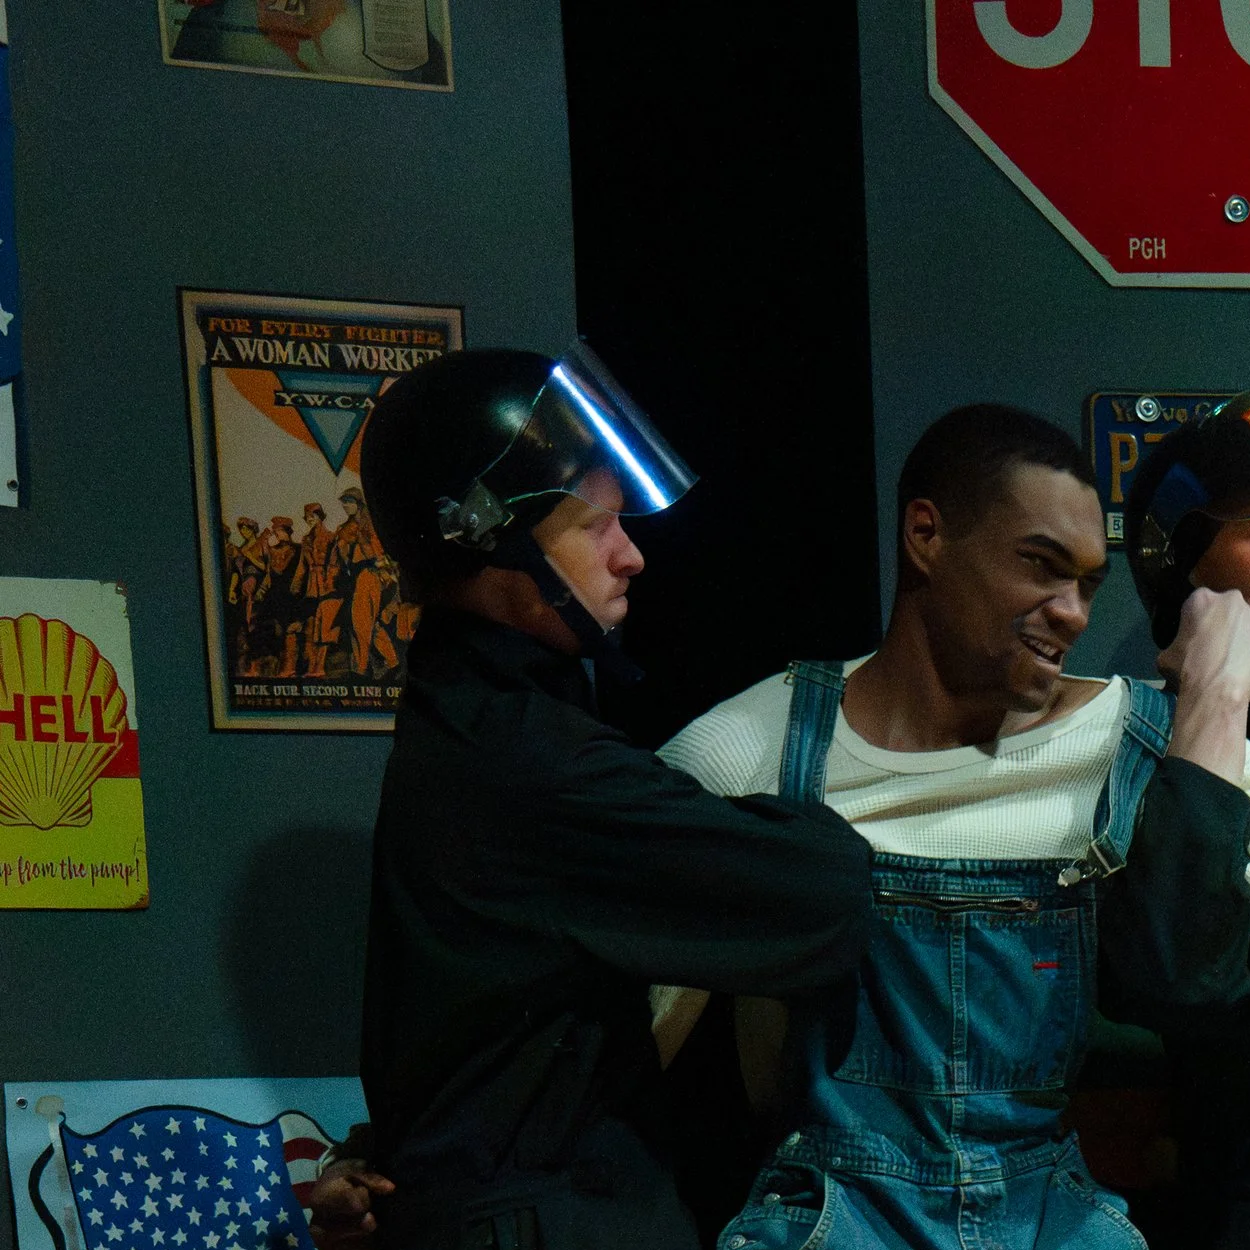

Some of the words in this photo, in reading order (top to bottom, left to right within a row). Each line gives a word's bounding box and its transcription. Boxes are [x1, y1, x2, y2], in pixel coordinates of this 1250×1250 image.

[1128, 238, 1167, 260] PGH
[208, 317, 252, 335] FOR
[261, 320, 336, 339] EVERY
[211, 335, 232, 362] A
[231, 337, 333, 368] WOMAN
[234, 684, 269, 696] BACK
[273, 685, 300, 697] OUR
[302, 685, 349, 698] SECOND
[353, 685, 382, 698] LINE
[18, 855, 57, 886] from
[59, 855, 88, 881] the
[90, 858, 140, 888] pump!
